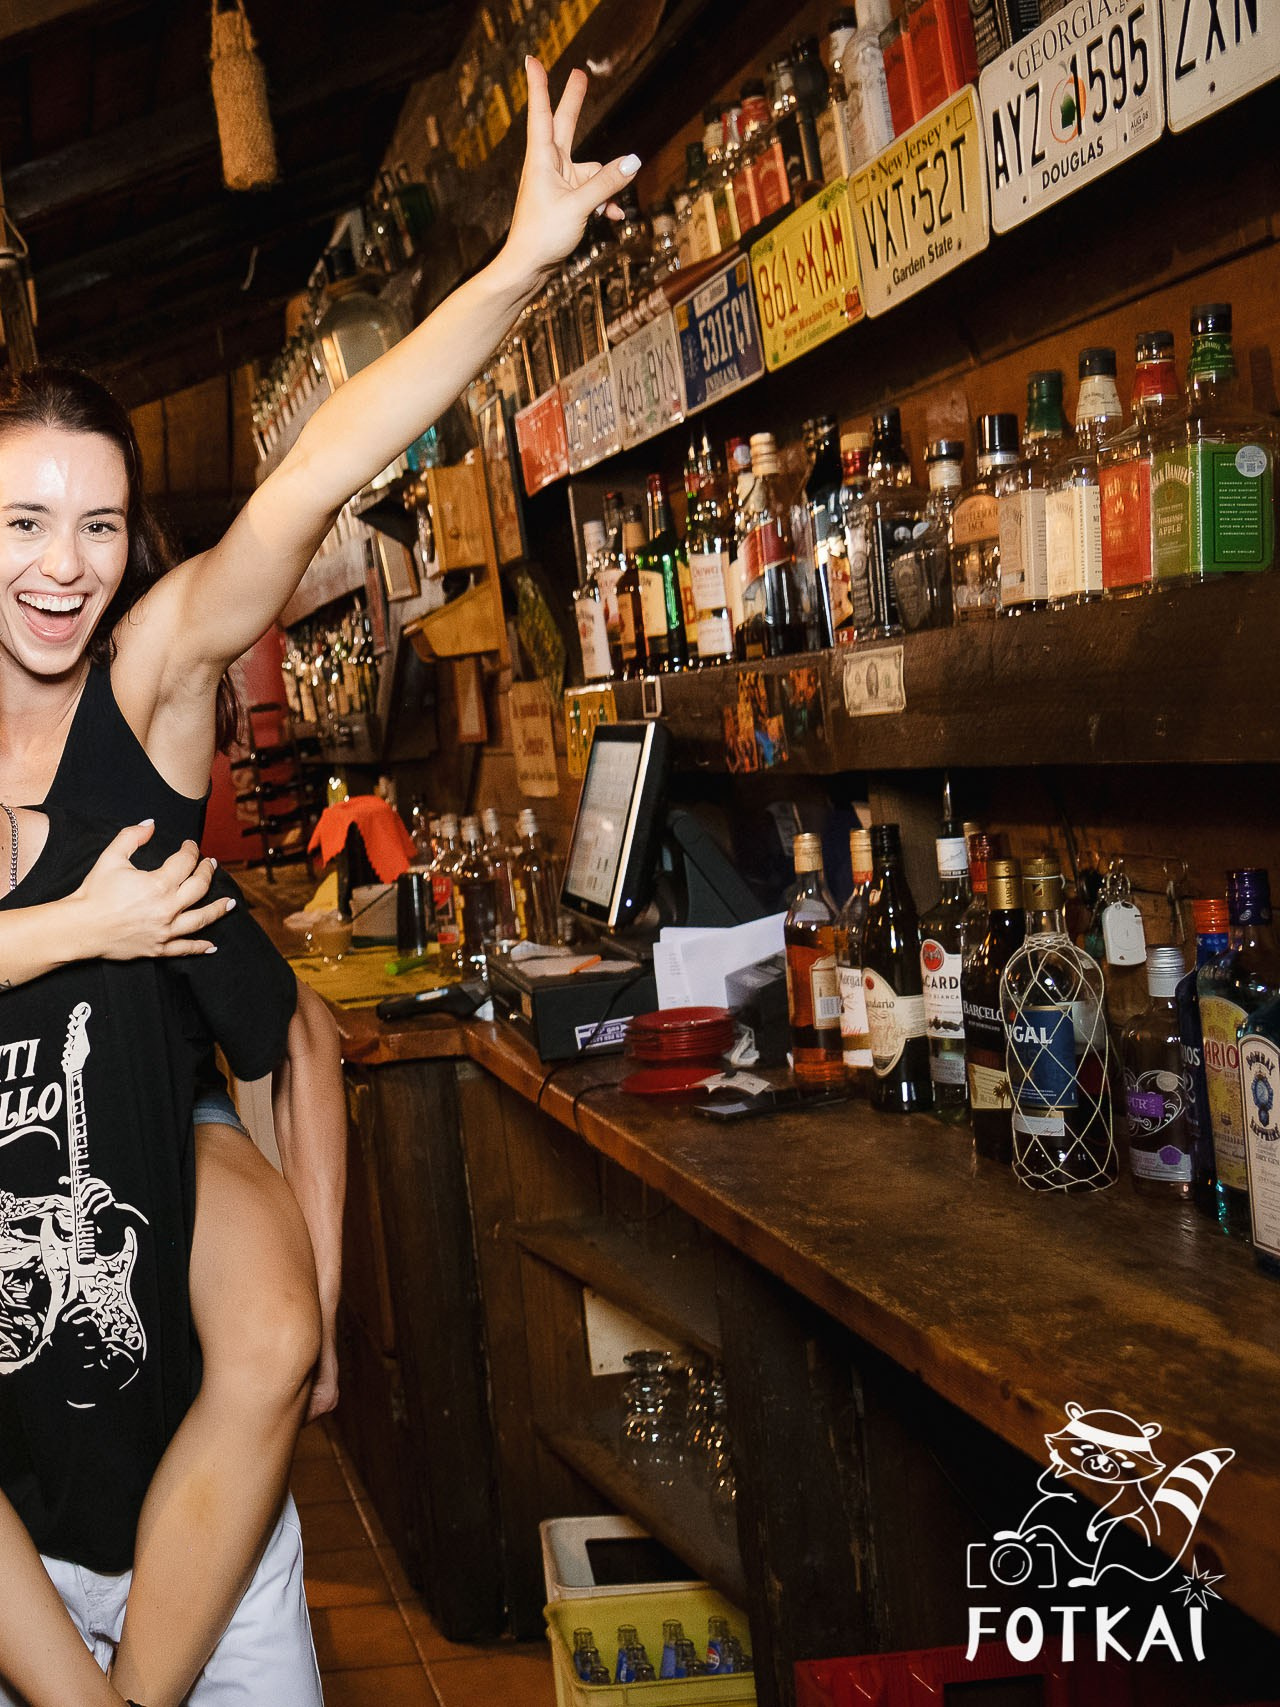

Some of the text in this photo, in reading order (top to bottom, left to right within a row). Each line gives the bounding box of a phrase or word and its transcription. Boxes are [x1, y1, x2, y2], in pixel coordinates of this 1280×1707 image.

[992, 81, 1046, 189] AYZ
[1070, 4, 1149, 137] 1595
[877, 124, 943, 183] New Jersey
[1041, 135, 1104, 190] DOUGLAS
[759, 206, 848, 329] 861 KAM
[892, 235, 953, 286] Garden State
[1158, 523, 1182, 536] APPLE
[923, 976, 959, 989] CARD
[1204, 1040, 1239, 1069] ARIO
[1246, 1050, 1276, 1076] BOMBAY
